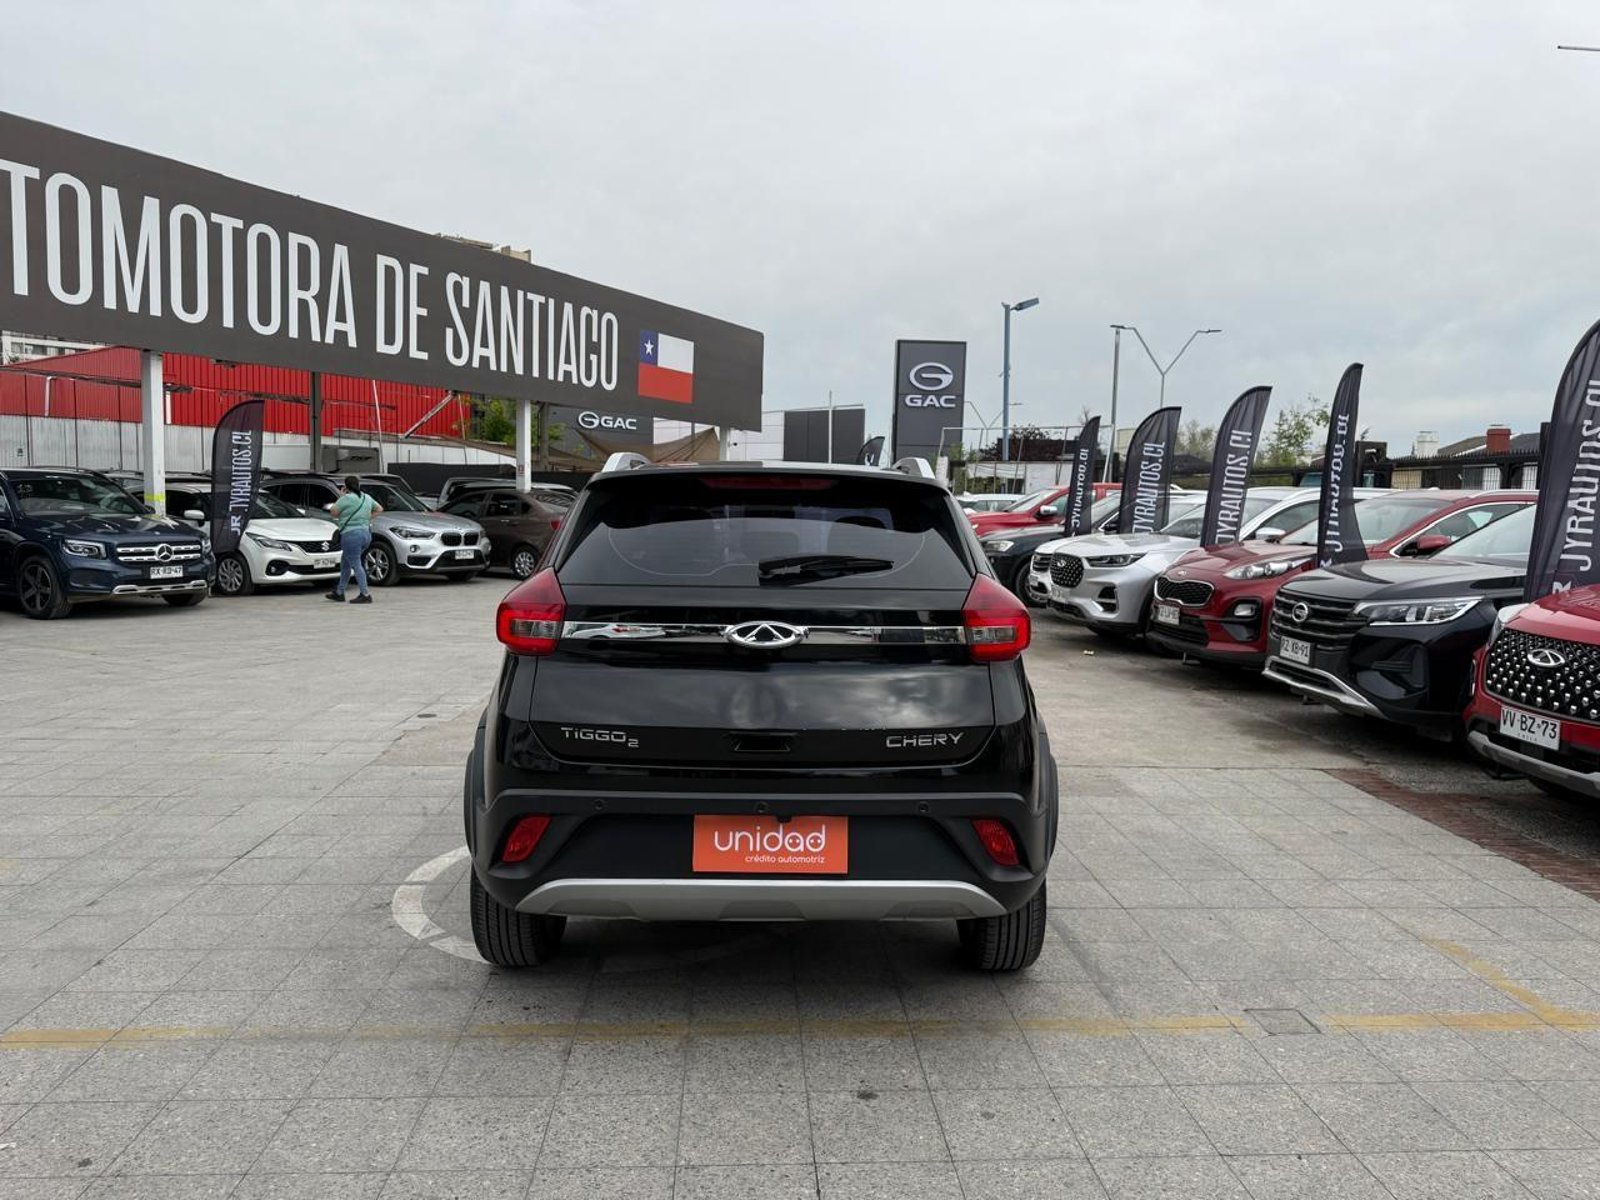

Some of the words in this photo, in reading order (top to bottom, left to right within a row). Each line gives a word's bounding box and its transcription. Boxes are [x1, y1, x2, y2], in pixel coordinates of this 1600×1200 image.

[376, 253, 429, 360] DE
[445, 271, 619, 391] SANTIAGO
[905, 394, 956, 408] GAC
[600, 415, 637, 430] GAC
[886, 732, 964, 748] CHERY
[714, 824, 826, 851] unidad
[745, 854, 776, 863] crédito
[778, 855, 825, 864] automotriz
